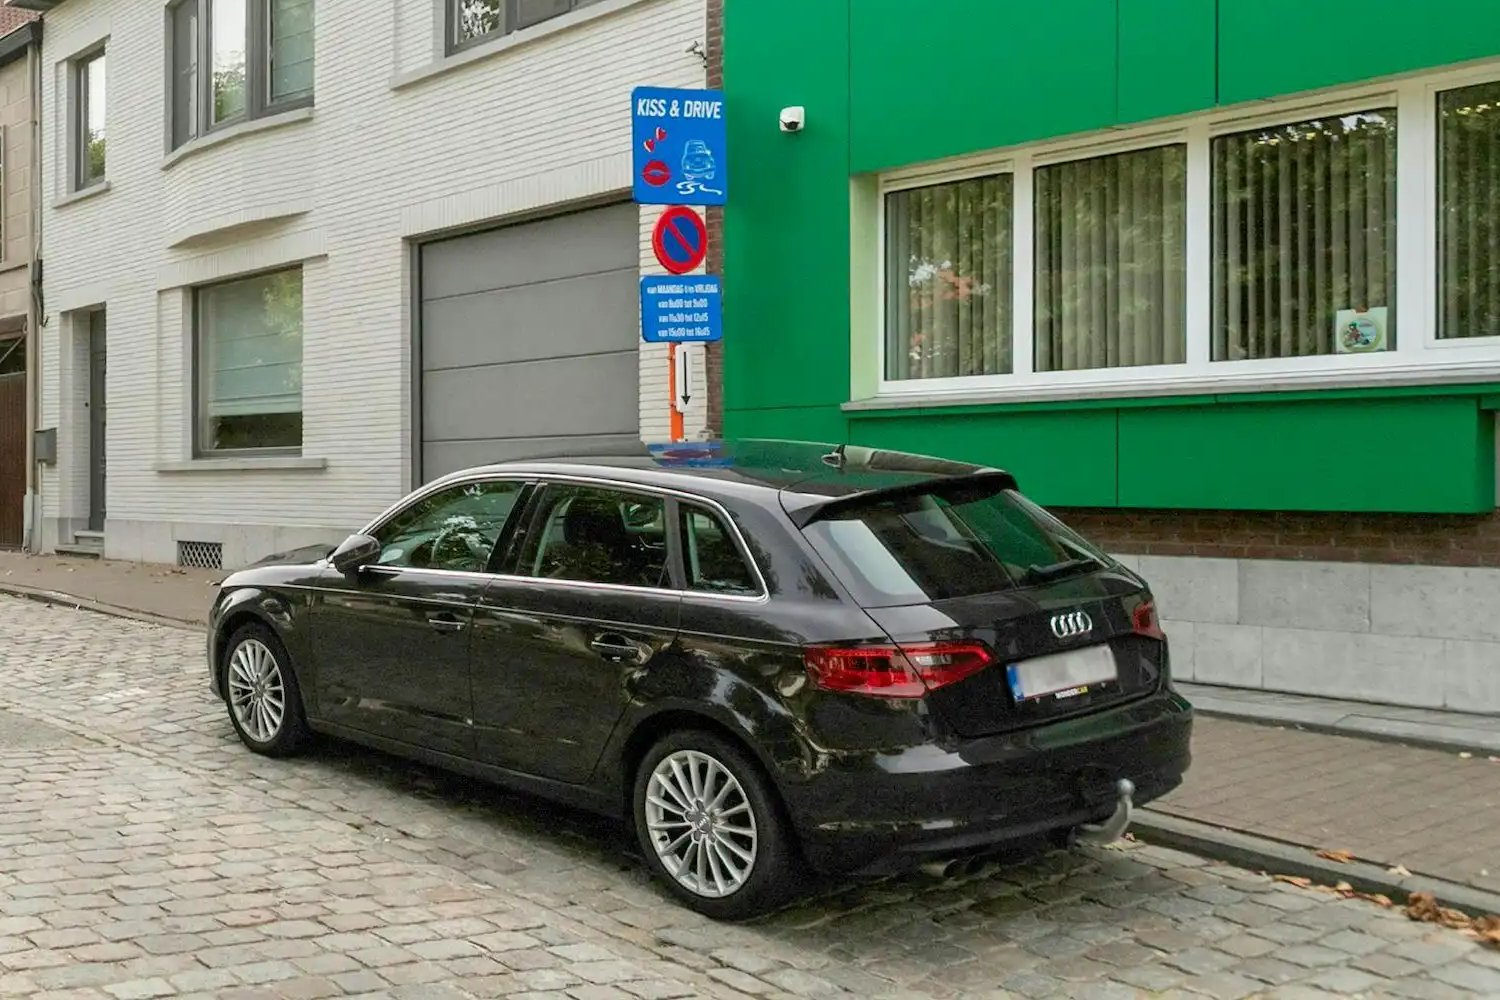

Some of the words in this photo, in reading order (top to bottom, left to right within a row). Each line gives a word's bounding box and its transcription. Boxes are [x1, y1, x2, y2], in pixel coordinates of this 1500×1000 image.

[637, 99, 666, 117] KISS
[669, 99, 680, 117] &
[684, 100, 722, 119] DRIVE
[684, 299, 692, 308] tot
[684, 314, 693, 322] tot
[686, 328, 694, 337] tot
